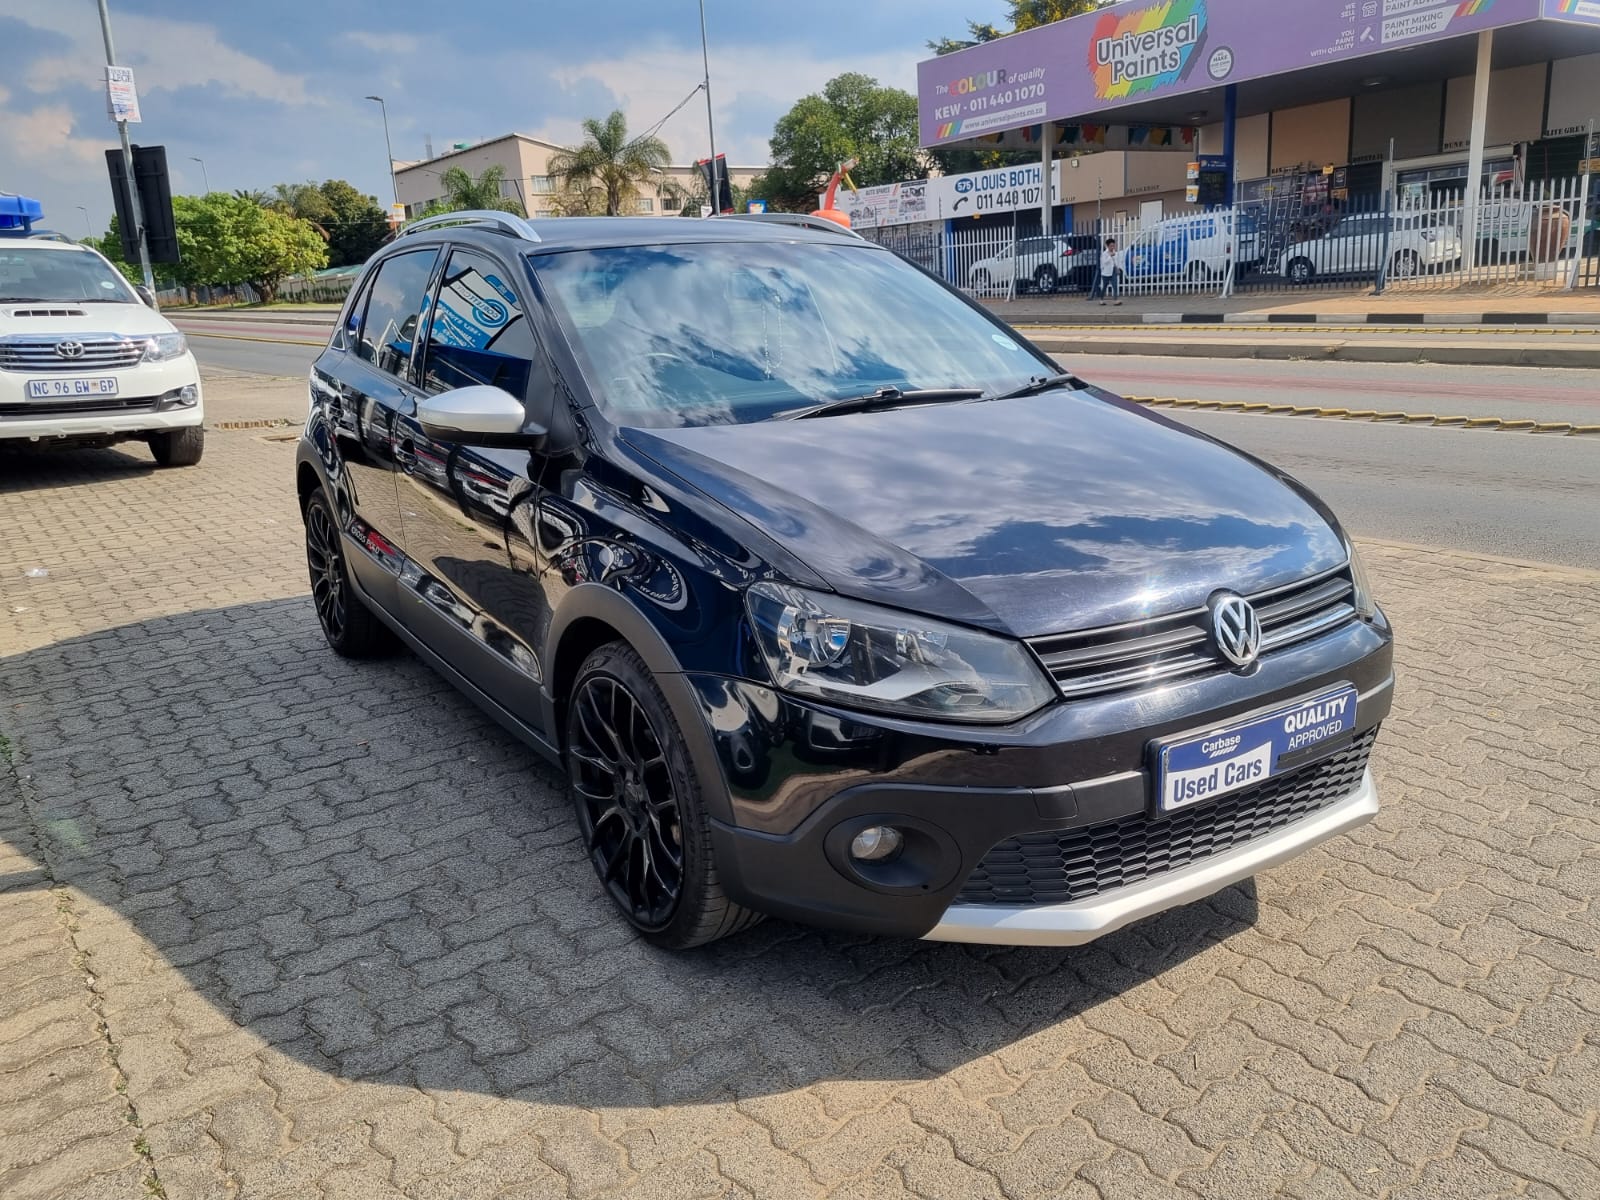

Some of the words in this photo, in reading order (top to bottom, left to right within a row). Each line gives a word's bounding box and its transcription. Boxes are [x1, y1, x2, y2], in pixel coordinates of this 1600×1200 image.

[1385, 19, 1409, 30] PAINT
[1411, 11, 1444, 24] MIXING
[1391, 22, 1437, 38] MATCHING
[1097, 16, 1197, 63] Universal
[1112, 50, 1180, 82] Paints
[935, 85, 949, 95] The
[949, 68, 1007, 97] COLOUR
[1008, 73, 1018, 84] of
[1018, 67, 1046, 82] quality
[934, 103, 961, 120] KEW
[969, 97, 988, 111] 011
[989, 91, 1013, 106] 440
[1014, 83, 1045, 101] 1070
[957, 181, 972, 191] 575
[974, 173, 1006, 192] LOUIS
[976, 193, 993, 210] 011
[33, 382, 49, 395] NC
[54, 381, 70, 394] 96
[75, 380, 90, 393] GW
[100, 379, 114, 392] GP
[1284, 696, 1349, 733] QUALITY
[1201, 734, 1241, 754] Carbase
[1288, 719, 1342, 750] APPROVED
[1173, 768, 1218, 803] Used
[1224, 758, 1262, 786] Cars
